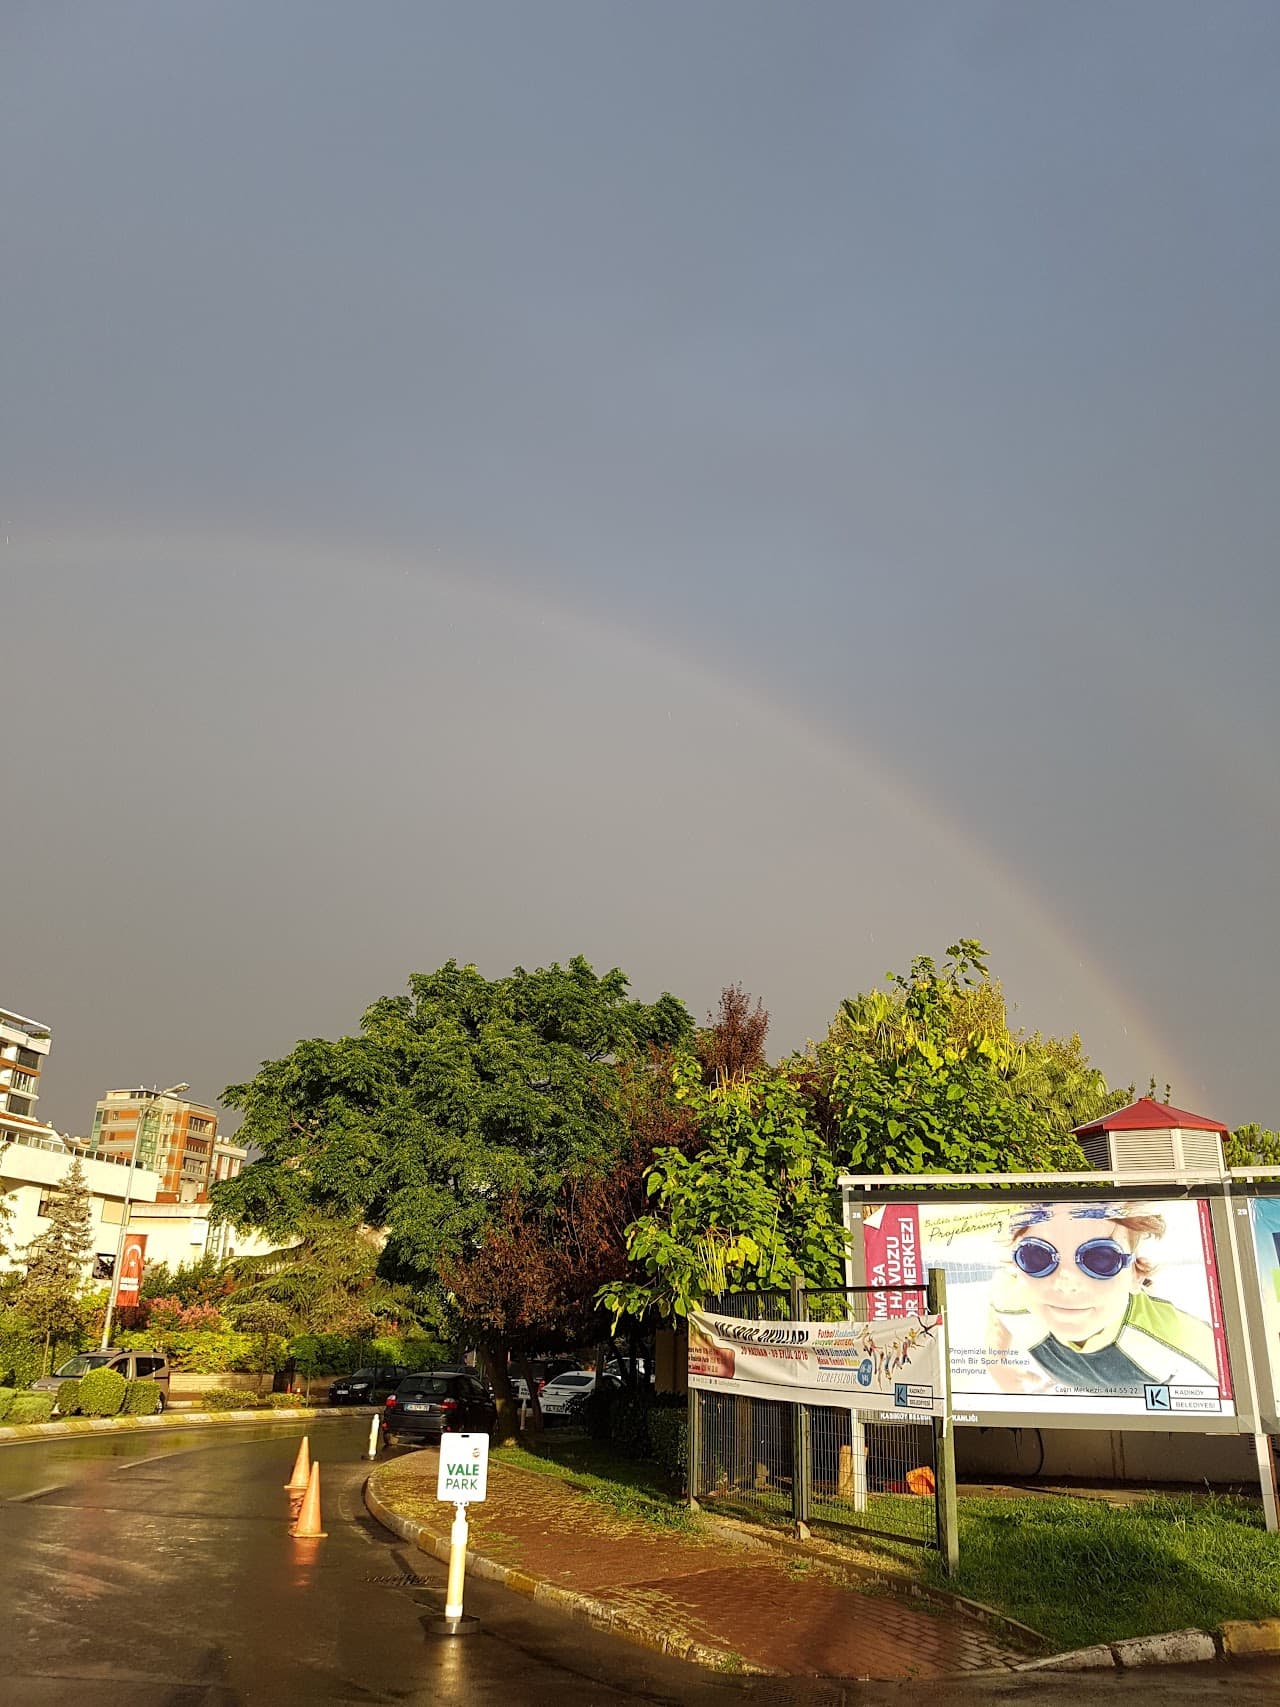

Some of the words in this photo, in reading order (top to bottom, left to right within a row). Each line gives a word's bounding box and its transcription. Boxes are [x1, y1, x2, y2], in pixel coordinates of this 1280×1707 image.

[871, 1264, 888, 1320] İMAĞA
[949, 1348, 987, 1356] Projemizle
[981, 1357, 999, 1366] Spor
[952, 1414, 978, 1422] KANLIĞI
[446, 1463, 480, 1476] VALE
[445, 1478, 478, 1490] PARK
